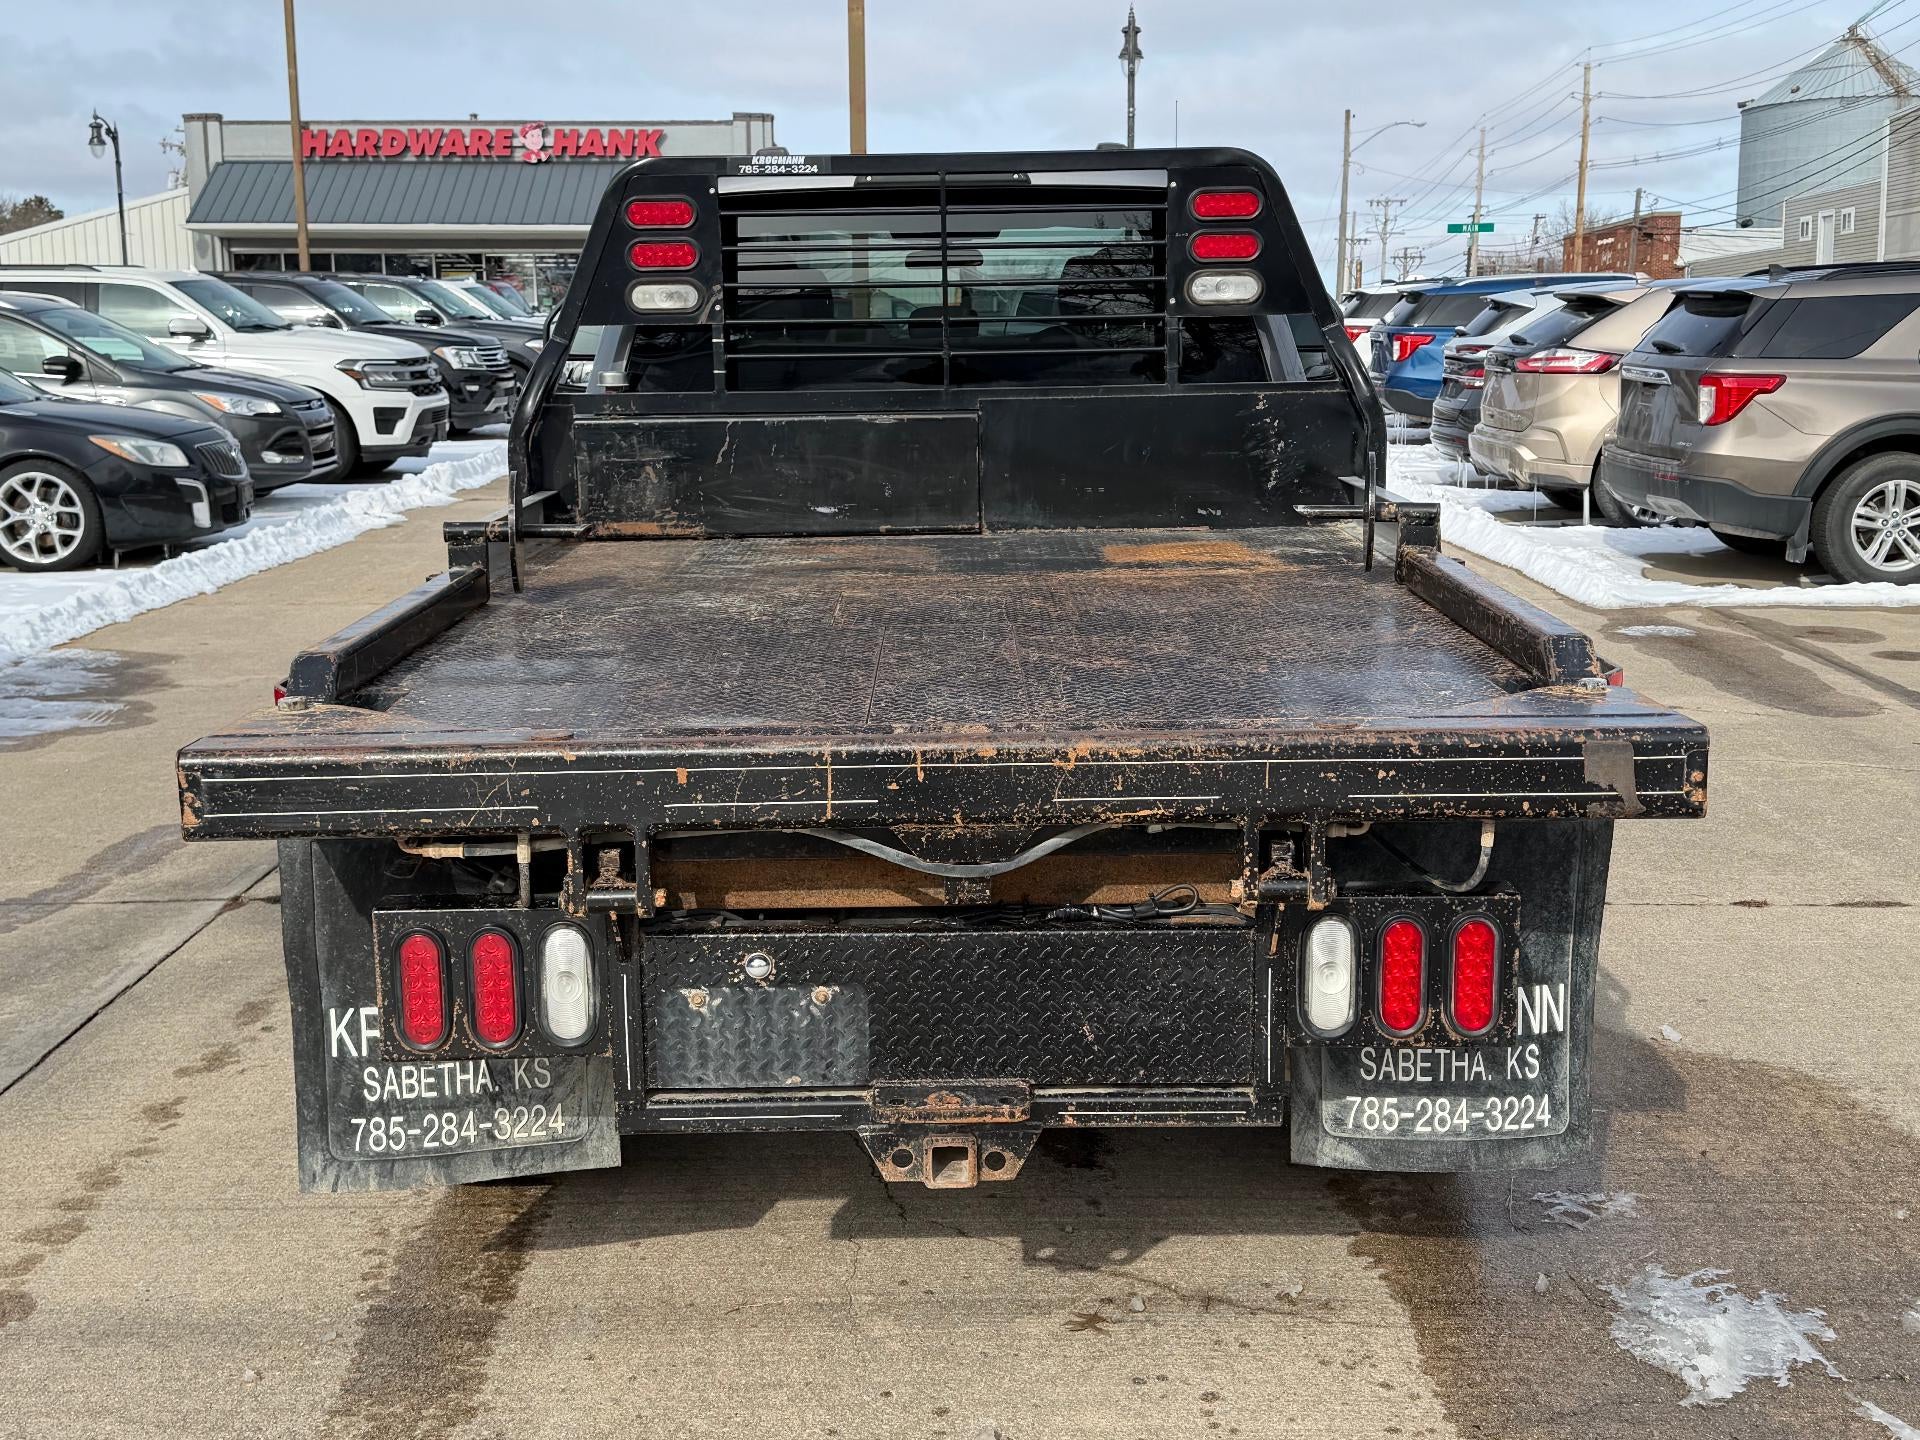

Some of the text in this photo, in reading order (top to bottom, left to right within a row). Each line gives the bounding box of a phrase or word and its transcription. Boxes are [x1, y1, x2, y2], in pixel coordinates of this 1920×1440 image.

[302, 129, 664, 157] HARDWARE HANK
[739, 165, 818, 174] 785-284-3224
[751, 156, 805, 164] KROGMANN
[1462, 224, 1479, 232] MAIN
[514, 1057, 551, 1090] KS
[1507, 1044, 1540, 1079] KS
[351, 1103, 565, 1151] 785-284-3224
[1346, 1094, 1551, 1133] 785-284-3224
